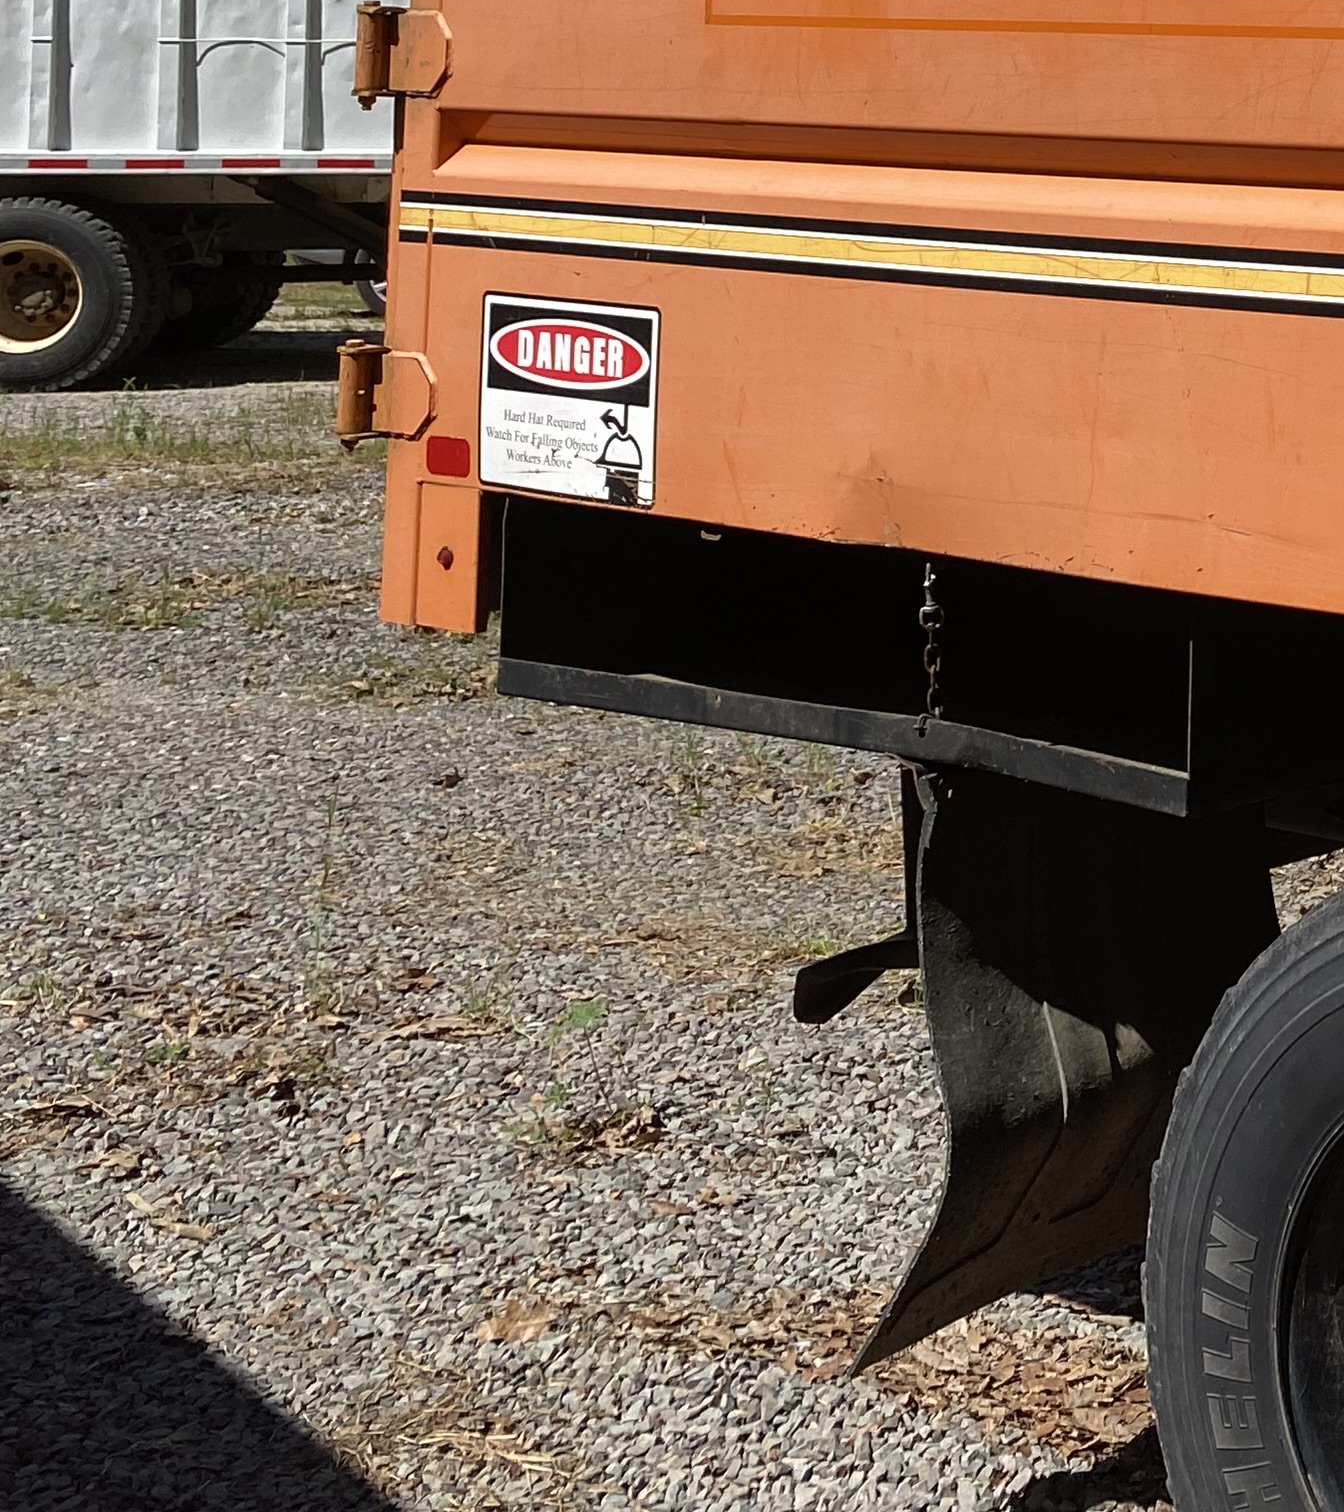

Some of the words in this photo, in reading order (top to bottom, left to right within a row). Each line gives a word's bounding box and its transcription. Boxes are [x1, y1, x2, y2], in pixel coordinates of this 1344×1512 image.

[517, 329, 624, 378] DANGER
[504, 409, 525, 423] Hard
[528, 412, 544, 425] Hat
[546, 415, 586, 431] Required
[486, 426, 512, 441] Watch
[514, 430, 530, 443] For
[531, 433, 563, 449] Falling
[565, 437, 598, 453] Objects
[506, 448, 541, 465] Workers
[544, 454, 573, 469] Above
